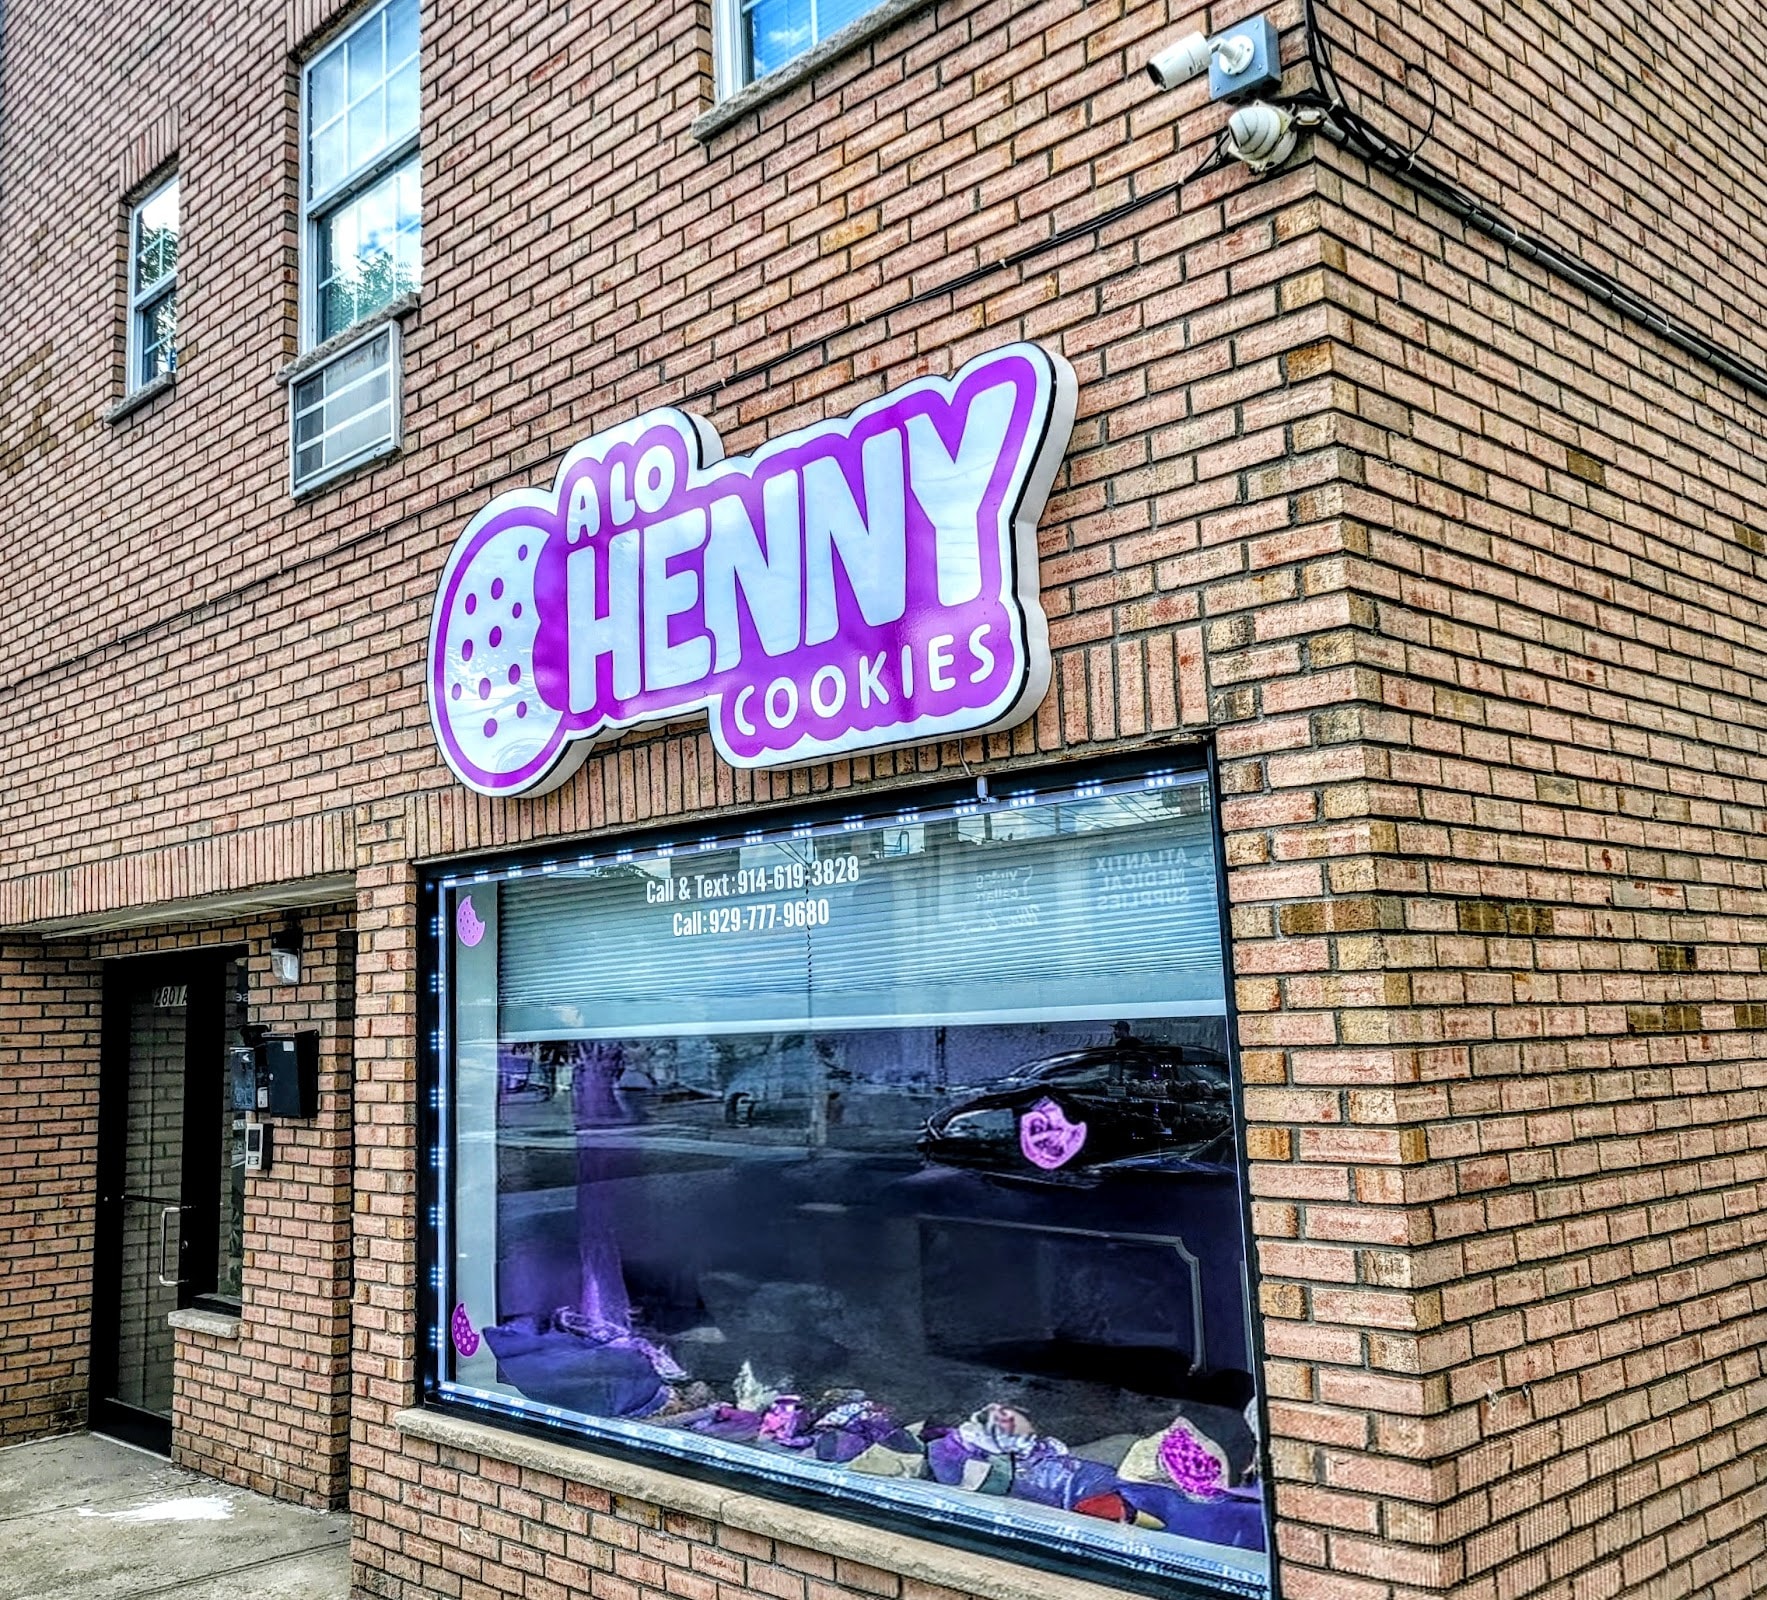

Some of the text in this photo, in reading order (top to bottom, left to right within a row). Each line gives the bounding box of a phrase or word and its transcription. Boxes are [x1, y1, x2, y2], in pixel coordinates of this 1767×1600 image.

[567, 444, 675, 545] ALO
[567, 380, 1017, 714] HENNY
[734, 623, 995, 736] COOKIES
[646, 878, 674, 904] Call
[678, 876, 691, 901] &
